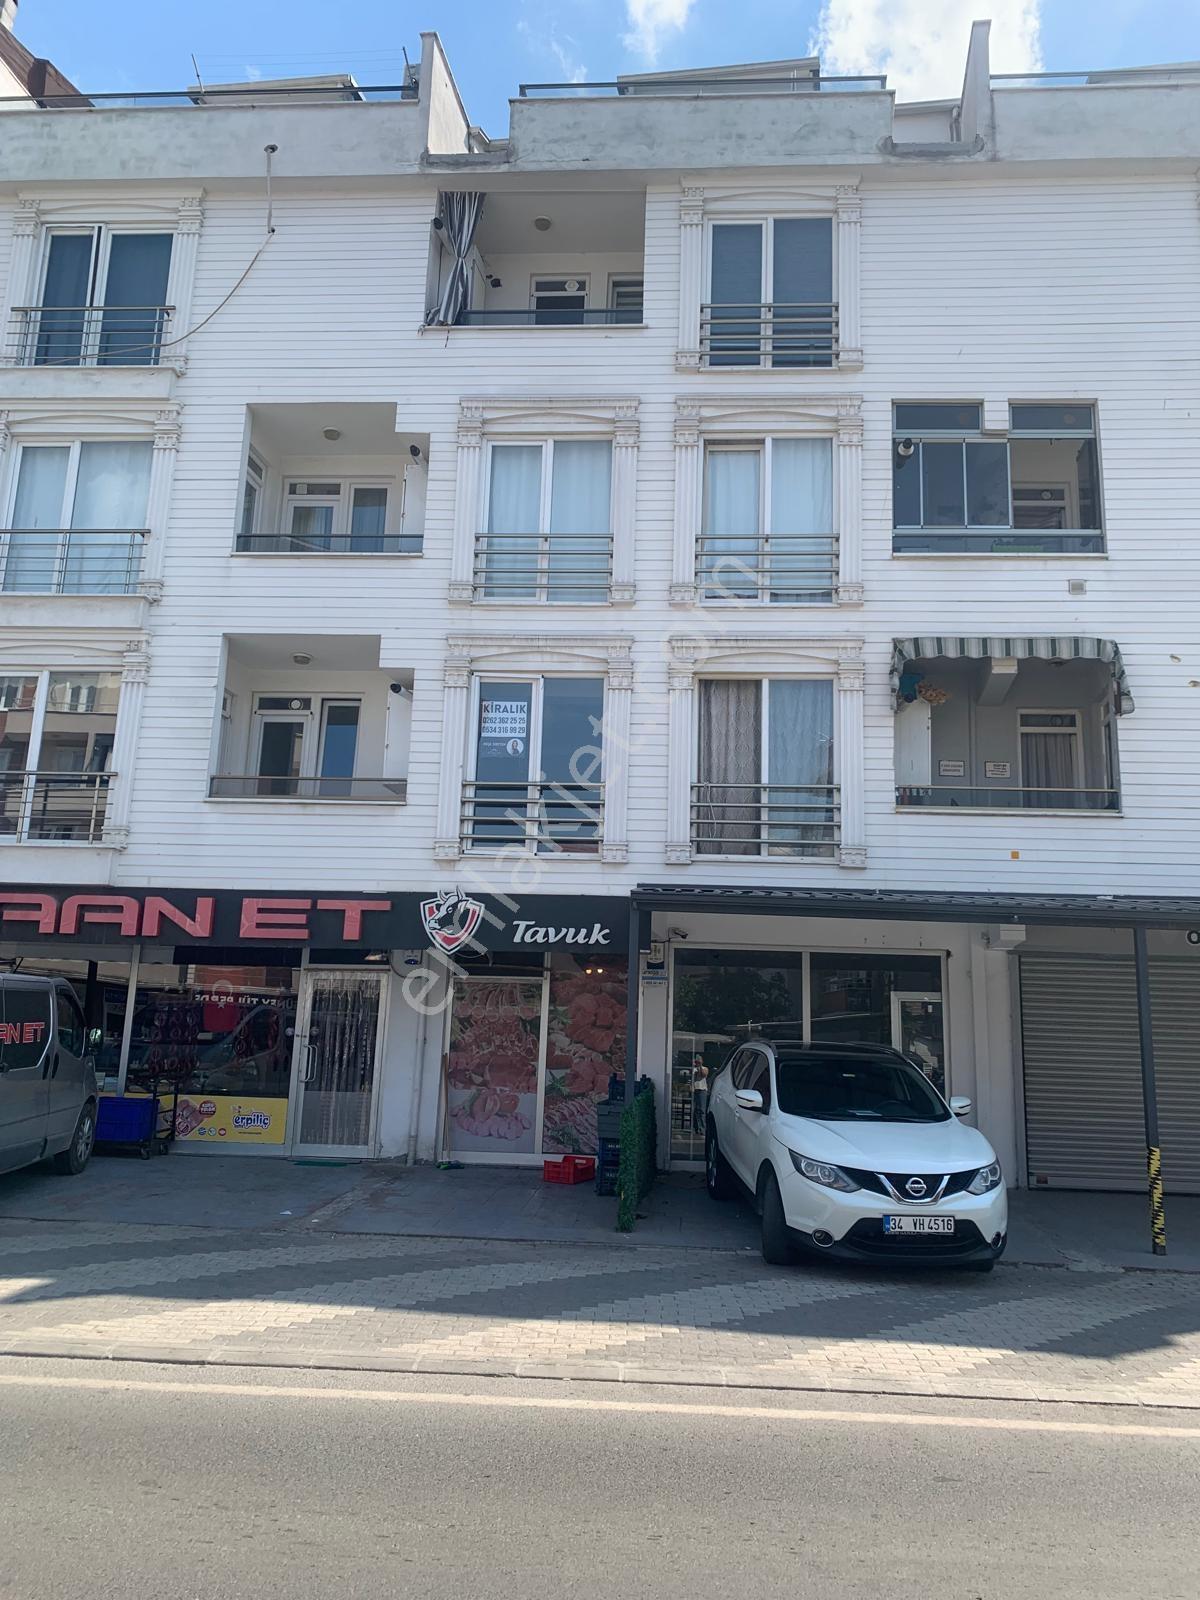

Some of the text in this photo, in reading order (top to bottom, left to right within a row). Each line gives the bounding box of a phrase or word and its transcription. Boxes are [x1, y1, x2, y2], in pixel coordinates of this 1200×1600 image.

[483, 702, 526, 714] KİRALIK
[239, 897, 392, 941] ET
[512, 920, 611, 945] Tavuk
[23, 1021, 45, 1043] ET
[234, 1112, 270, 1128] erpiliç
[890, 1217, 904, 1231] 34
[927, 1218, 953, 1231] 4516
